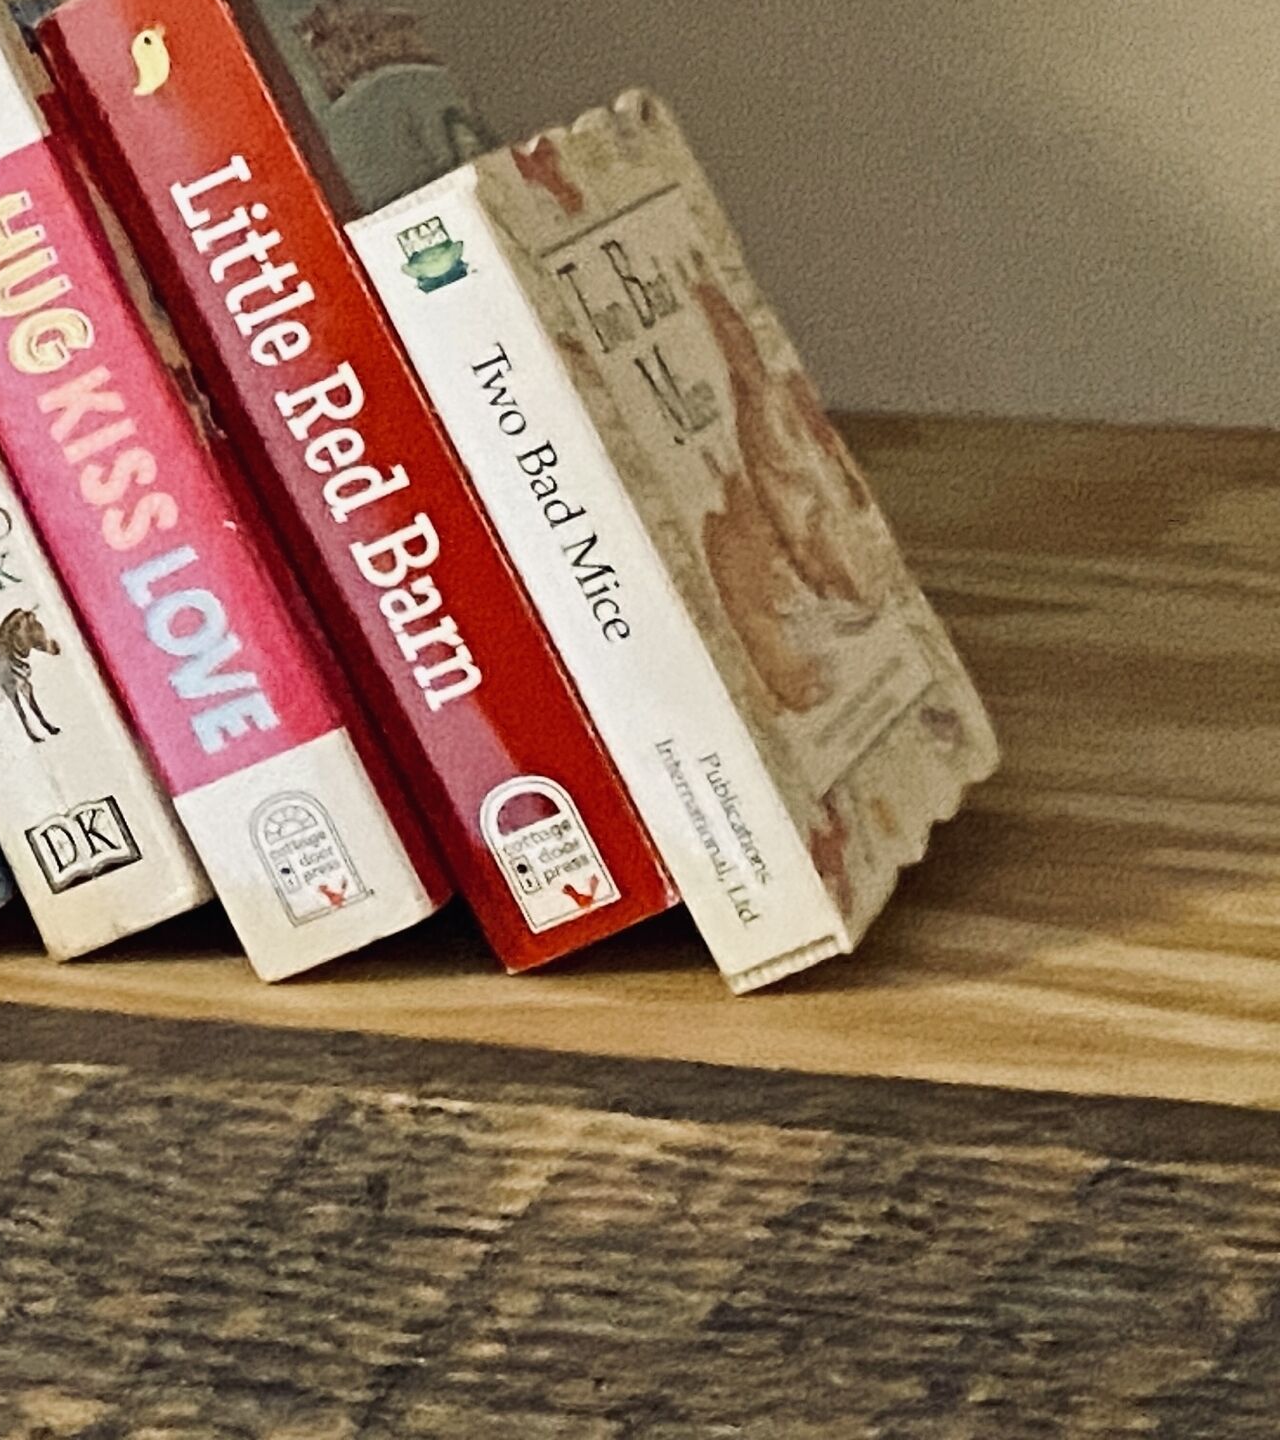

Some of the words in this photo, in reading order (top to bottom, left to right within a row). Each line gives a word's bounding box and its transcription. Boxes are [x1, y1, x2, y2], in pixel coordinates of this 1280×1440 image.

[38, 366, 181, 552] KISS
[120, 544, 282, 756] LOVE
[169, 155, 316, 368] Little
[274, 361, 412, 524] Red
[349, 512, 485, 714] Barn
[470, 341, 528, 437] Two
[515, 439, 587, 530] Bad
[561, 530, 632, 644] Mice
[40, 804, 125, 875] DK
